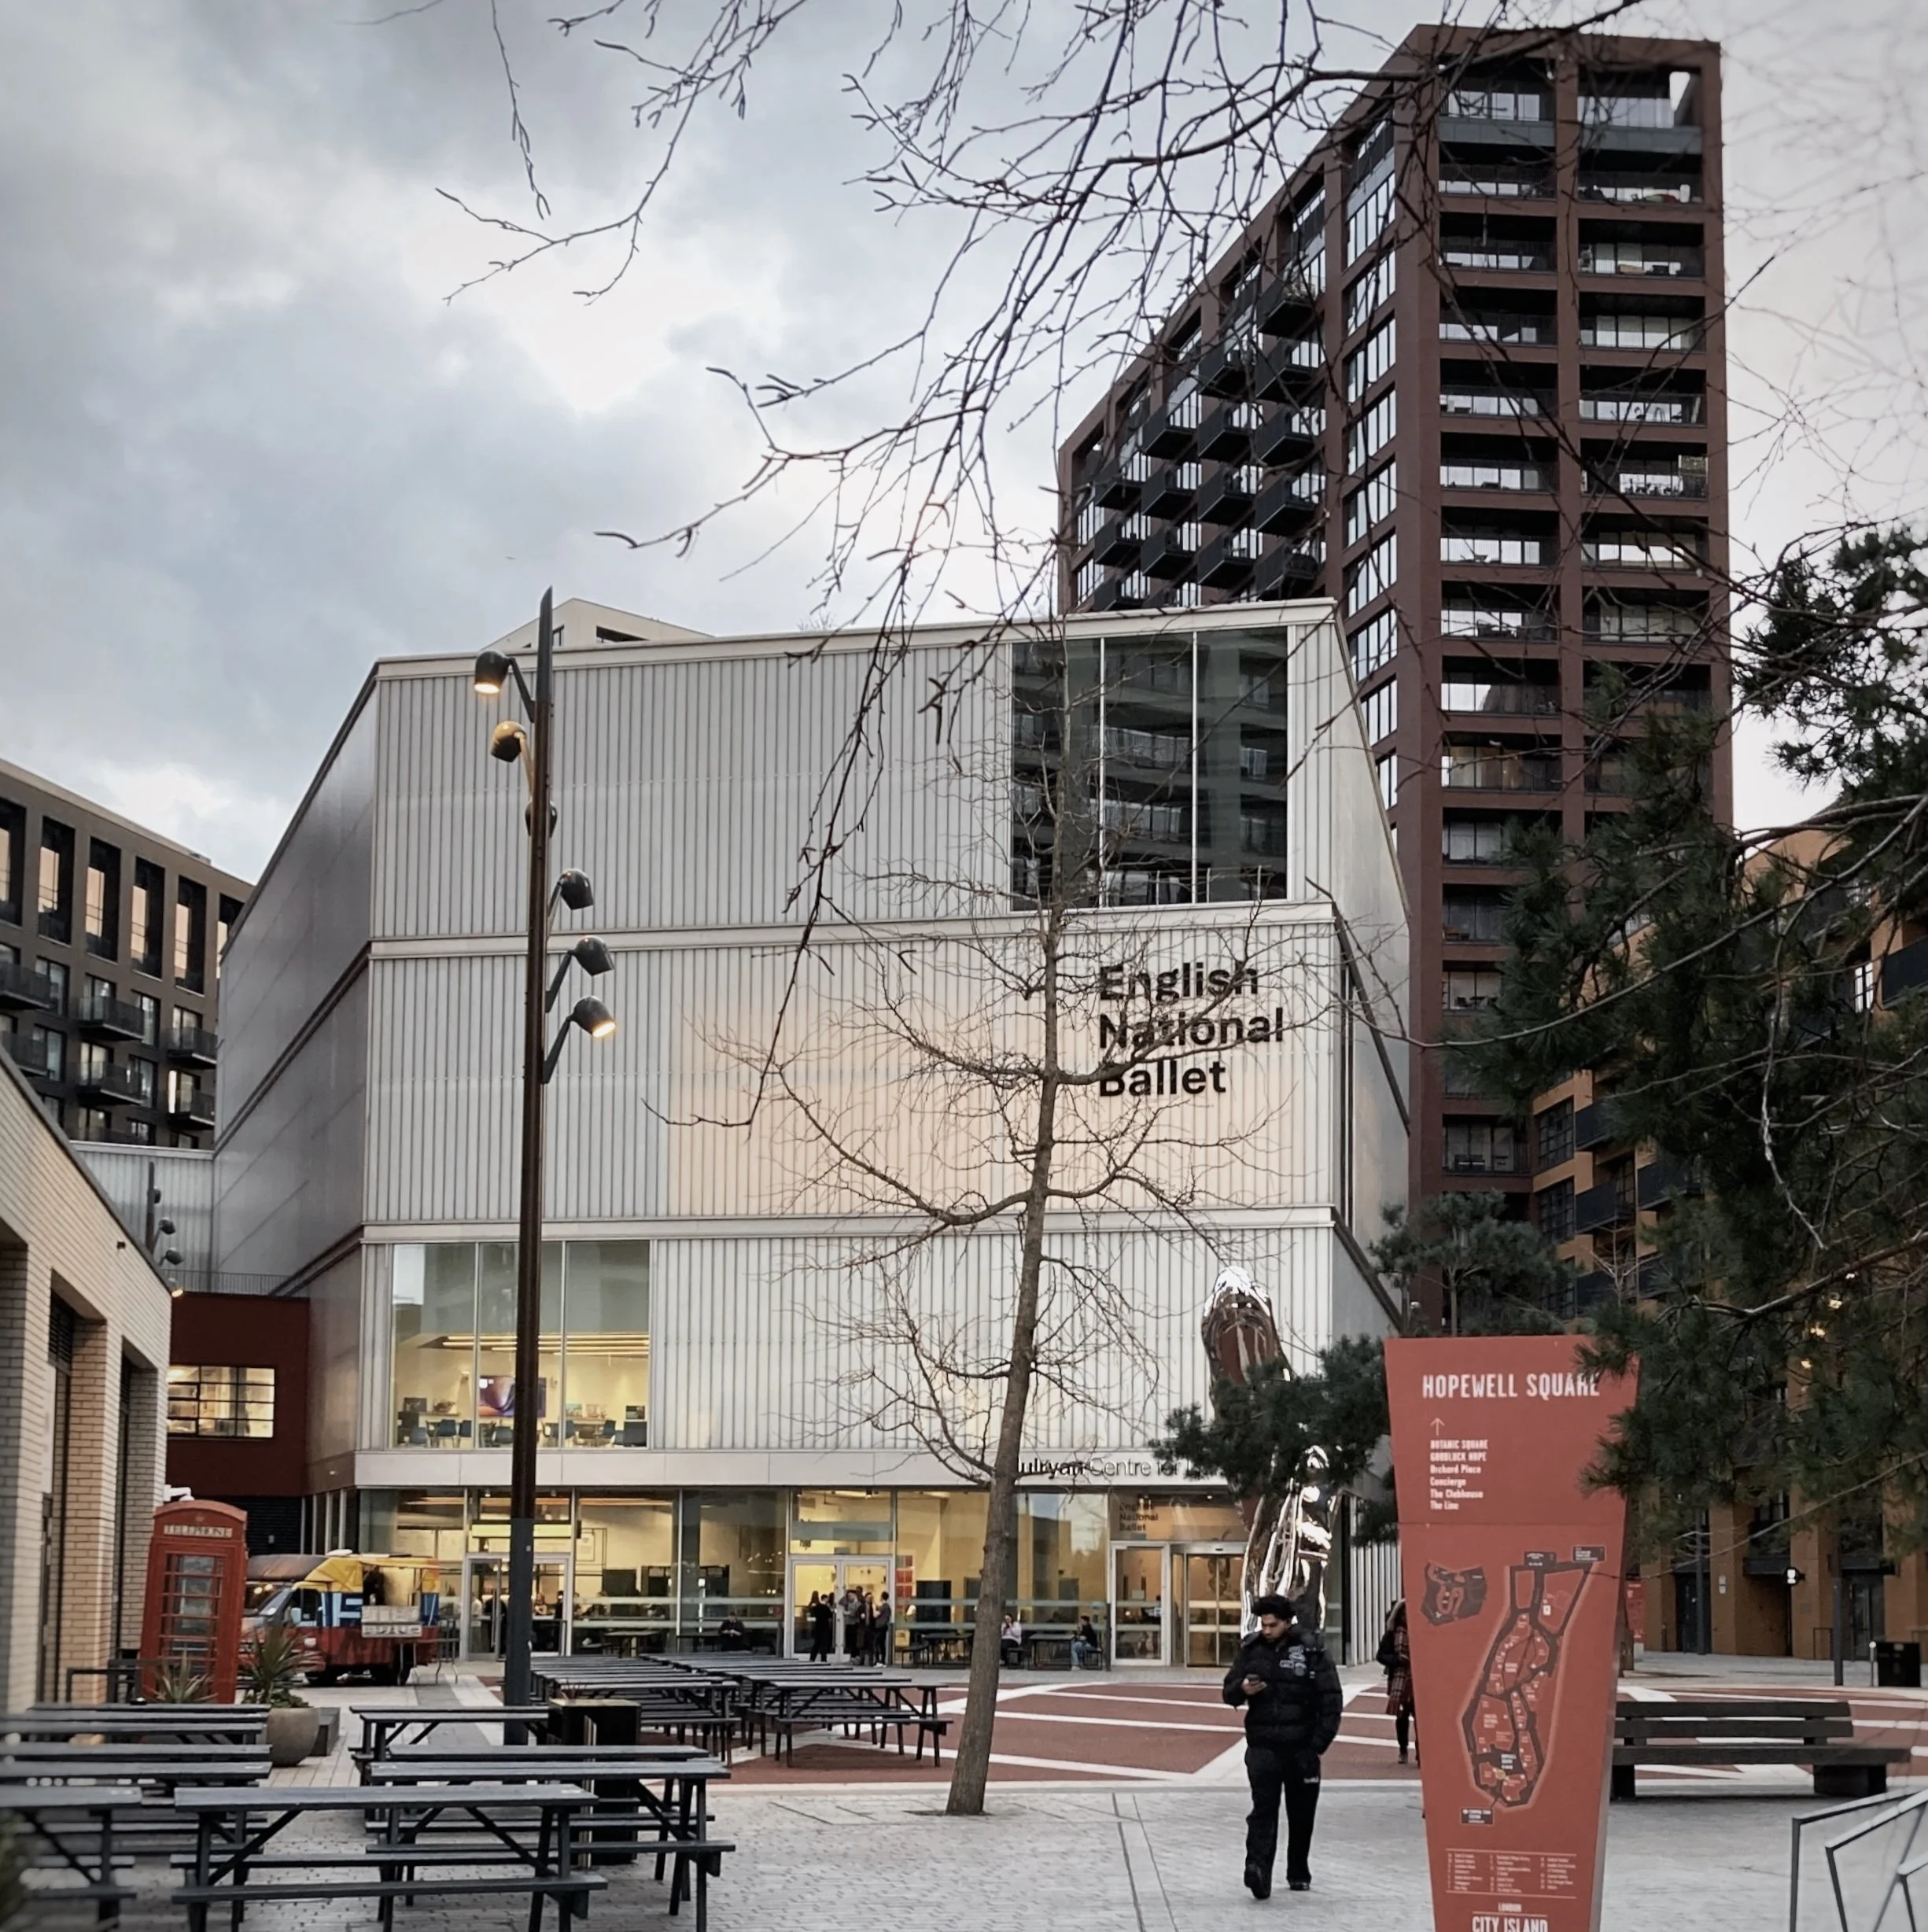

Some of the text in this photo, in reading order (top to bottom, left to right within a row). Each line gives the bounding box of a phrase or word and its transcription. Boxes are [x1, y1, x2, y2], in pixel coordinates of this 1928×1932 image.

[1100, 961, 1258, 1005] English
[1100, 1008, 1283, 1049] National
[1100, 1060, 1226, 1097] Ballet
[1422, 1373, 1600, 1400] HOPEWELL SQUARE
[1089, 1458, 1152, 1476] Centre
[1473, 1915, 1549, 1932] CITY ISLAND
